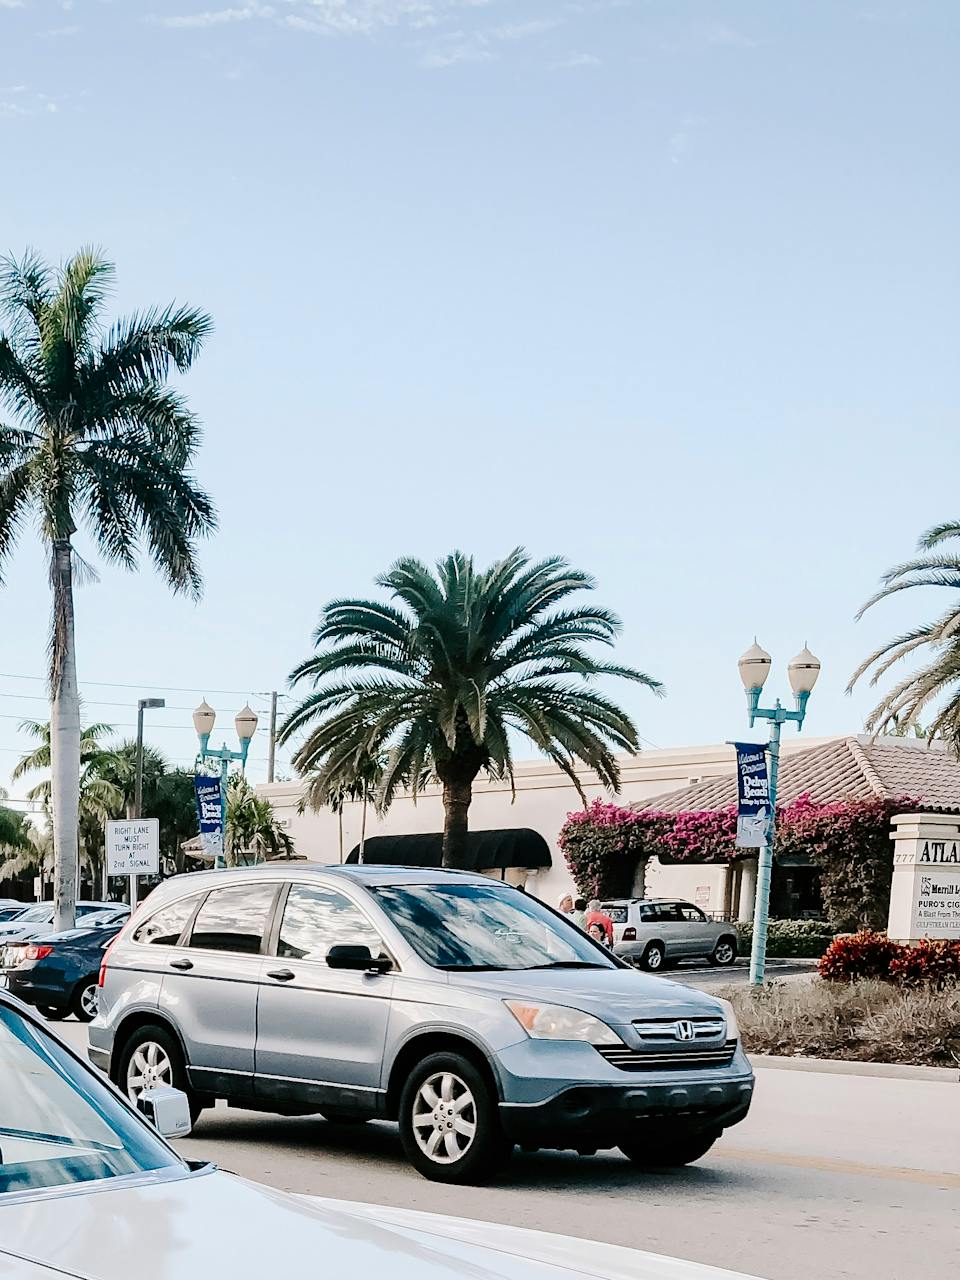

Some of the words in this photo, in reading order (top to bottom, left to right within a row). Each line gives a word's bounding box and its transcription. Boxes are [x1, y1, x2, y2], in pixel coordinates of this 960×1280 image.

[743, 775, 767, 788] Delray
[744, 786, 767, 798] Beach
[114, 827, 130, 835] RIGHT
[134, 826, 149, 834] LANE
[920, 841, 960, 863] ATLA
[896, 854, 915, 863] 777
[932, 884, 953, 894] Merrill
